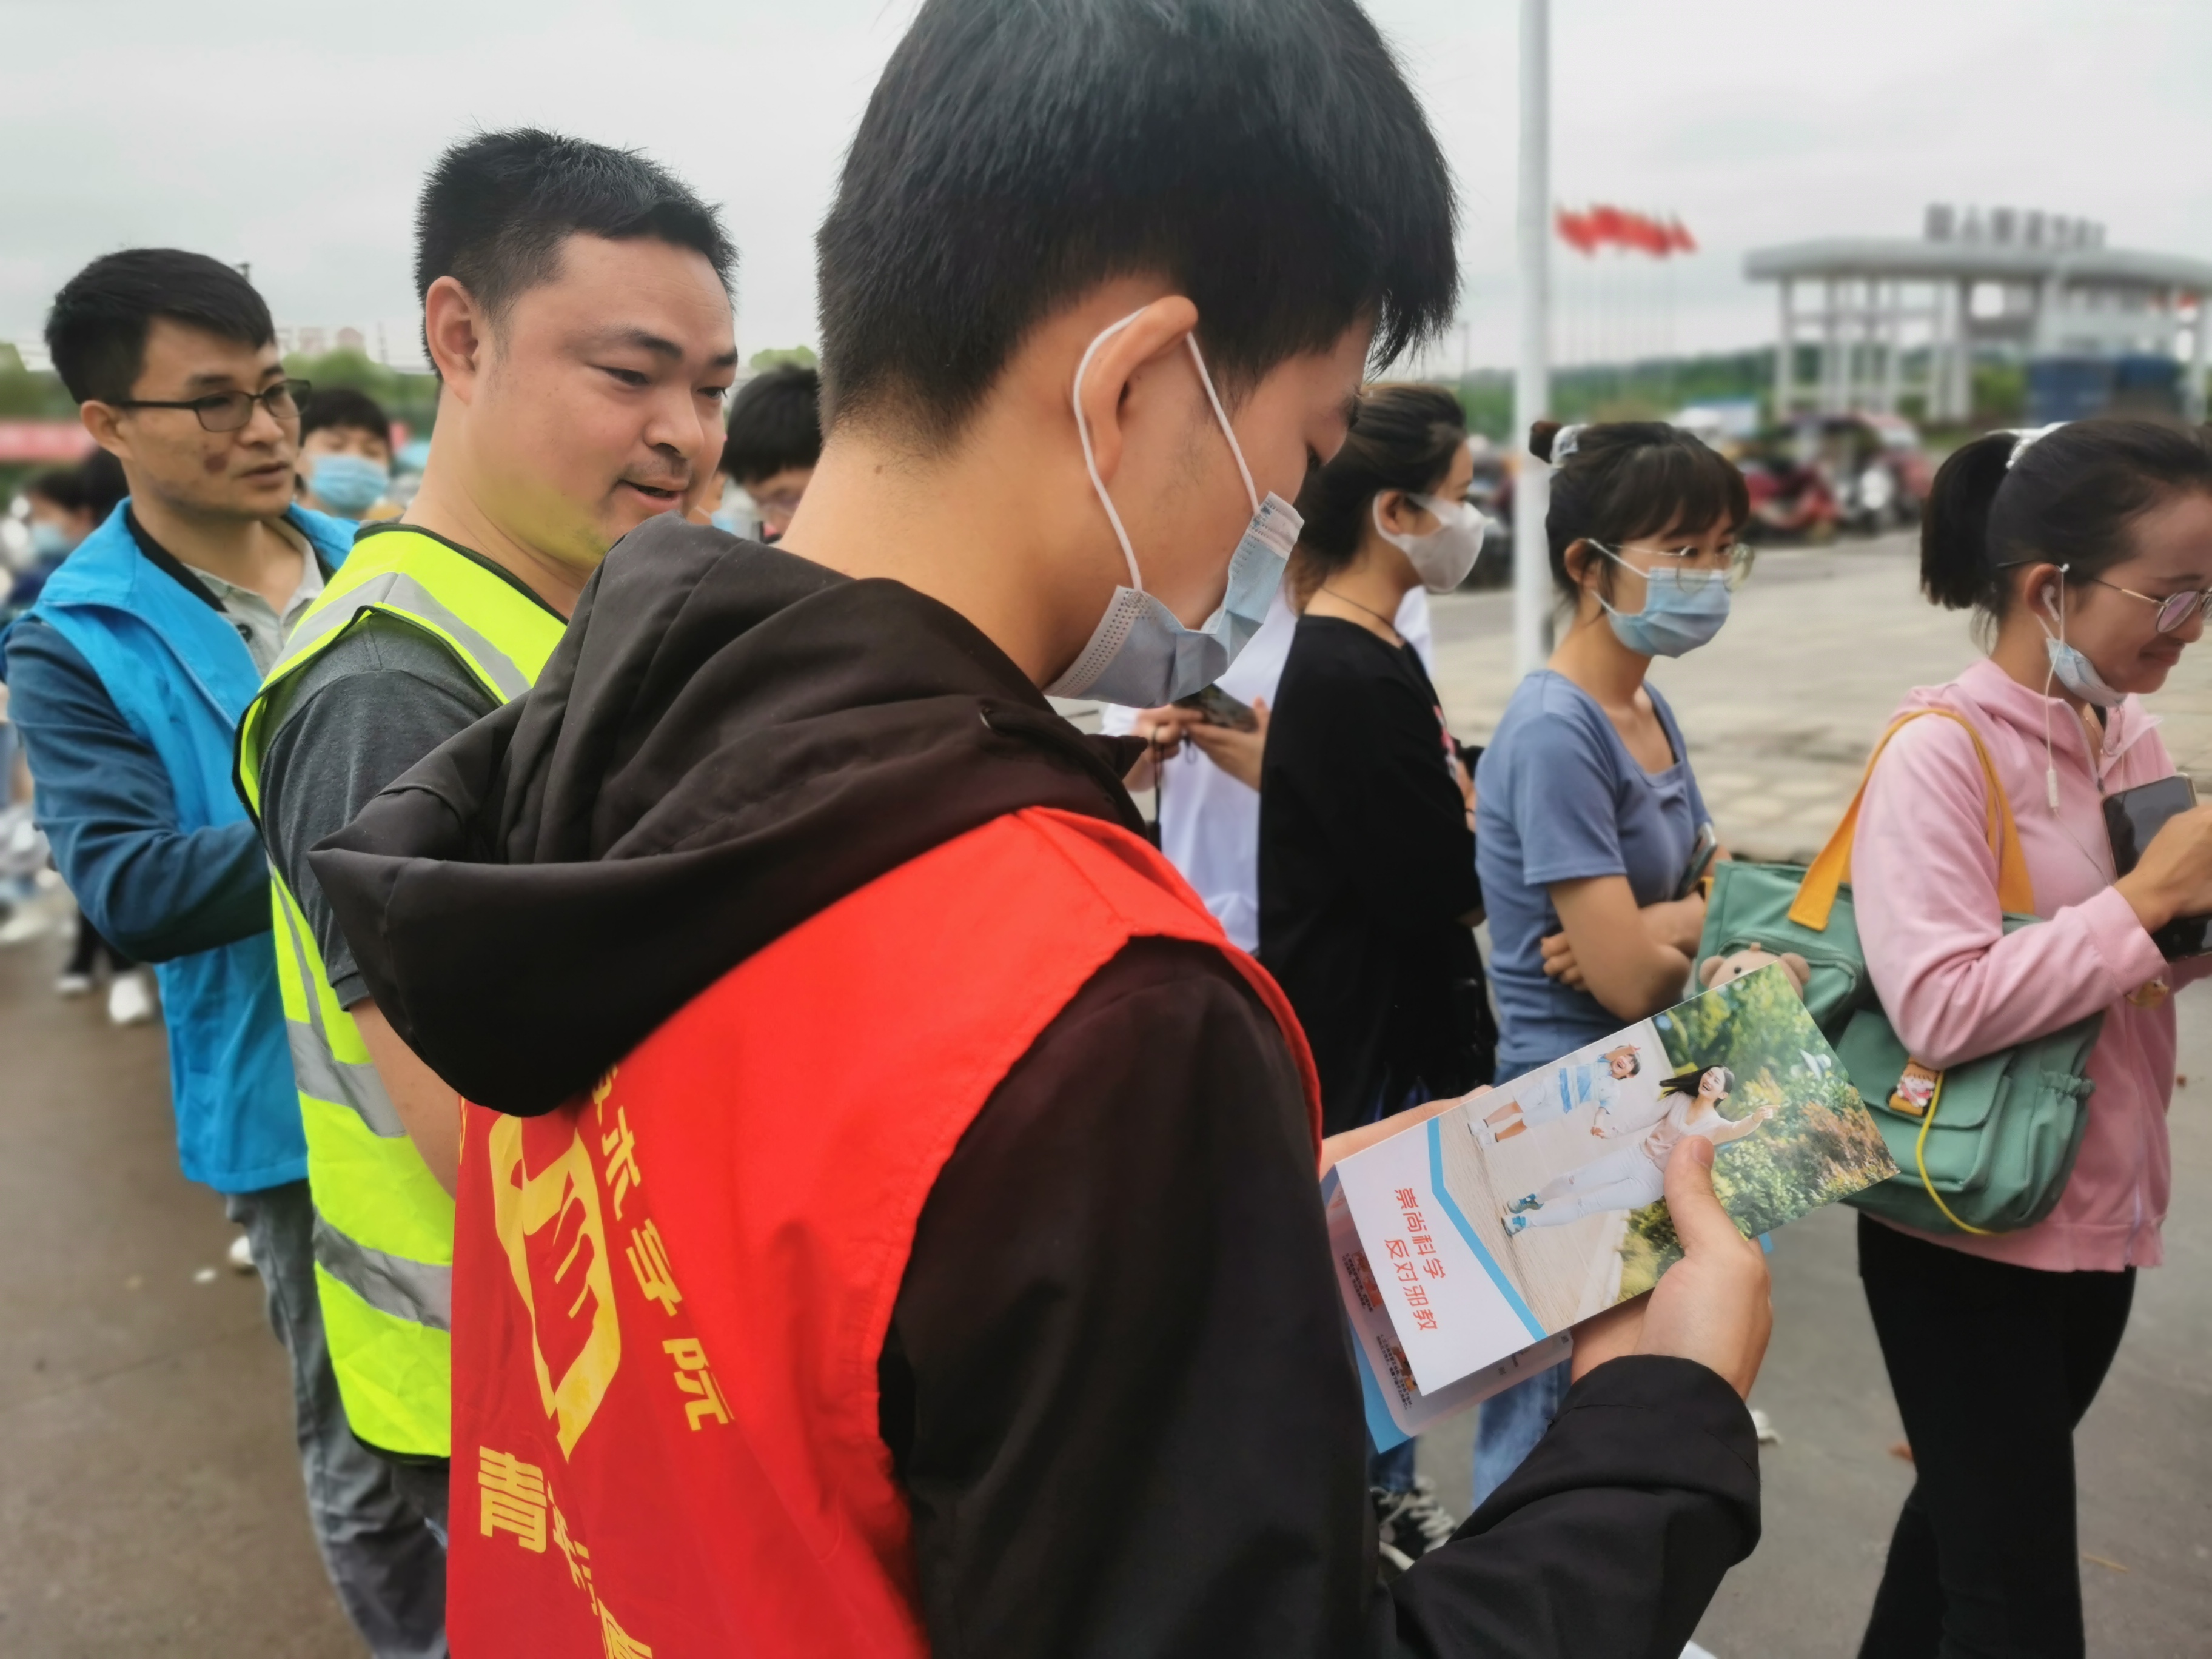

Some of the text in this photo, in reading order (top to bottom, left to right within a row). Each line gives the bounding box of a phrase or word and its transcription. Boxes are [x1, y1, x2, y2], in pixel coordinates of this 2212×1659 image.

[1394, 1188, 1446, 1279] 崇尚科学
[1384, 1239, 1438, 1331] 反对邪教
